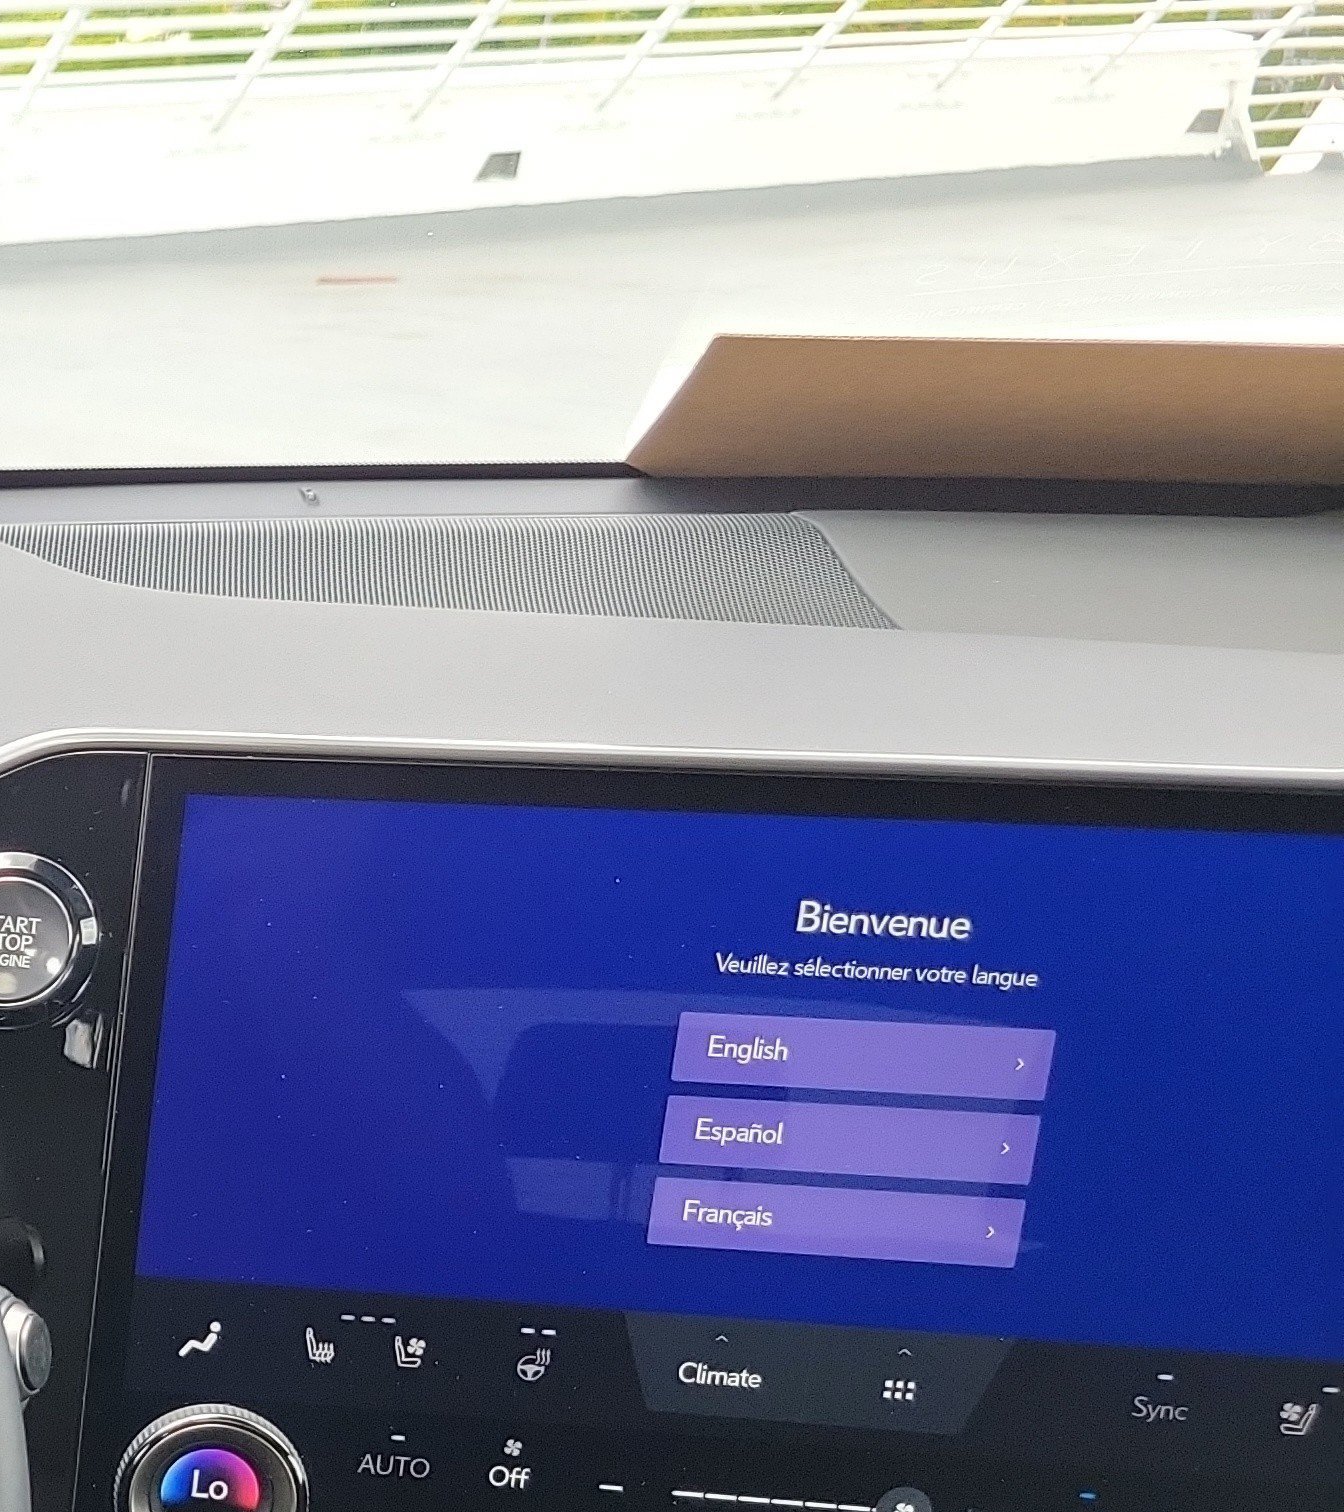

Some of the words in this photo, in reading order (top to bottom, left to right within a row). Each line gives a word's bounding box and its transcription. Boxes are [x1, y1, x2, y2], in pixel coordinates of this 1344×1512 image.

[796, 900, 972, 939] Bienvenue
[716, 952, 789, 976] Veuillez
[794, 958, 911, 982] sélectionner
[915, 966, 967, 985] votre
[971, 963, 1038, 990] langue
[707, 1034, 788, 1065] English
[694, 1117, 783, 1148] Español
[682, 1199, 773, 1230] Français
[678, 1362, 762, 1390] Climate
[1131, 1396, 1188, 1422] Sync
[357, 1453, 431, 1479] AUTO
[488, 1465, 531, 1489] Off
[190, 1470, 228, 1500] Lo
